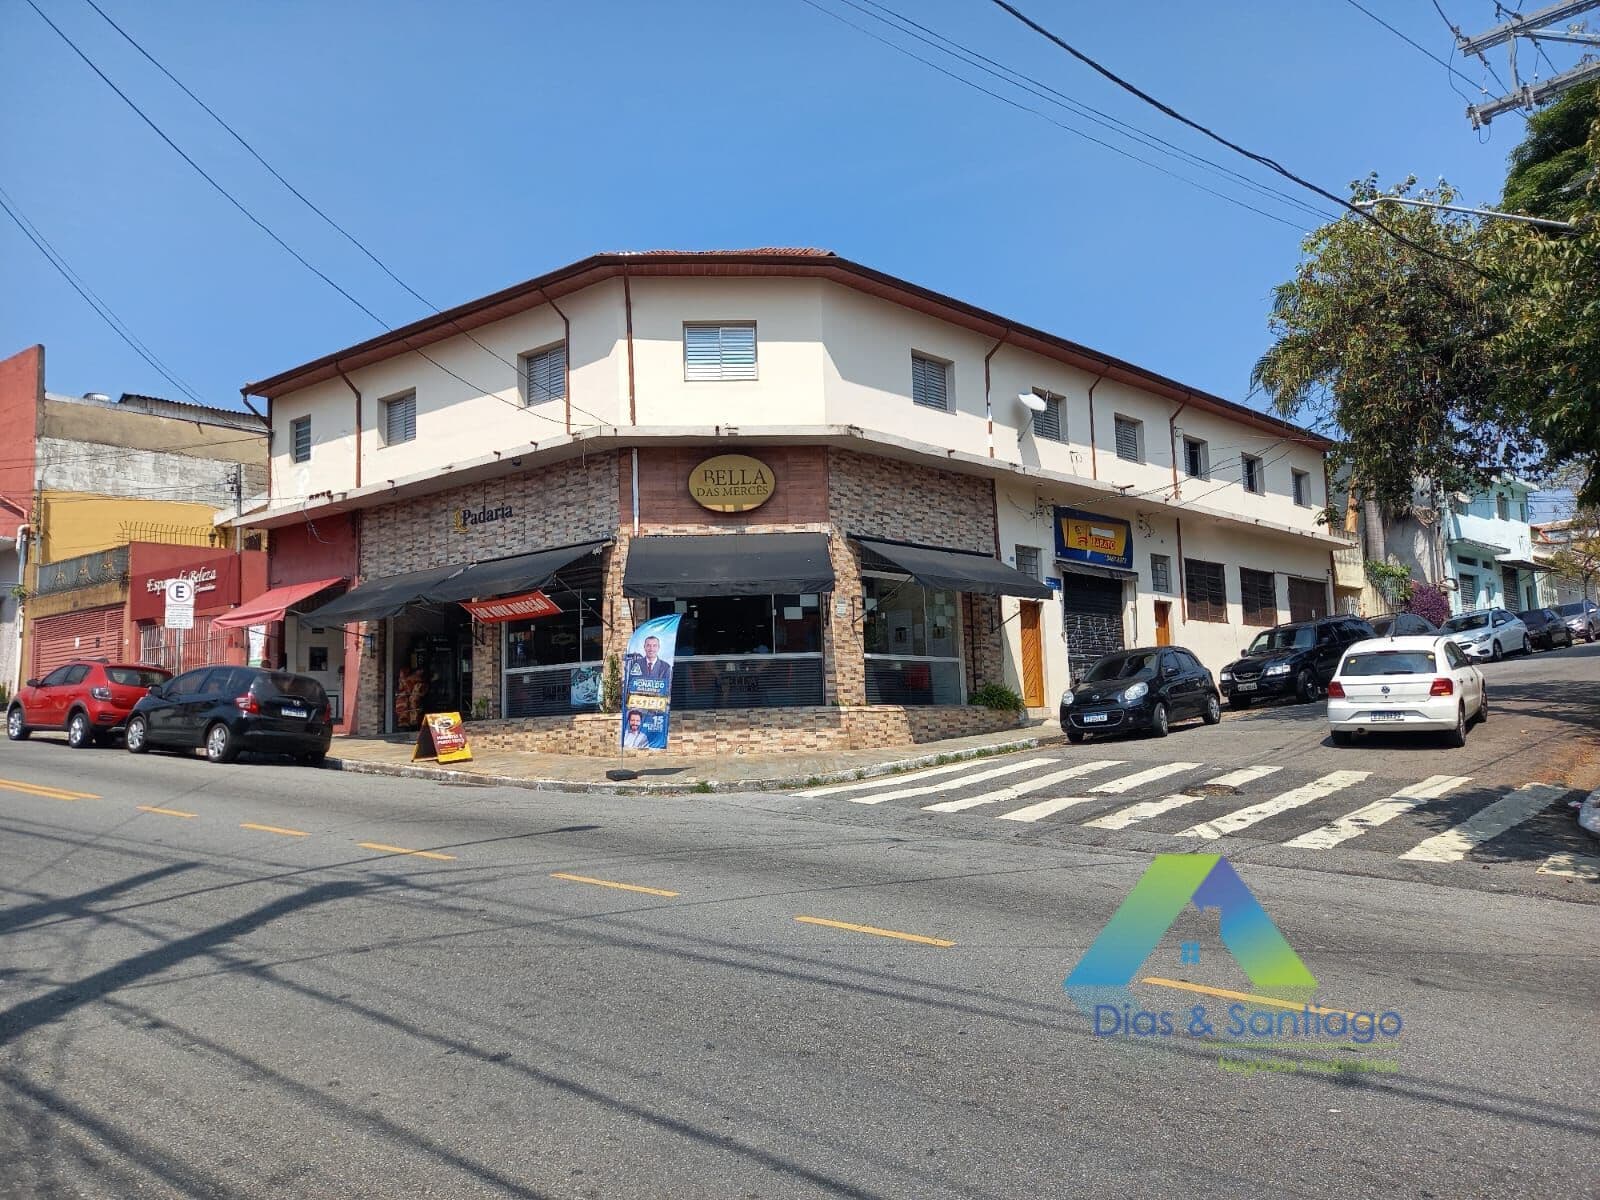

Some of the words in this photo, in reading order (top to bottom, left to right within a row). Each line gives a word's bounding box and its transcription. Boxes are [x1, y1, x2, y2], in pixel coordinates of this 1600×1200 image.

[704, 467, 767, 485] BELLA
[696, 487, 720, 497] DAS
[722, 485, 769, 496] MERCÊS
[461, 502, 513, 527] Padaria
[175, 585, 185, 599] E
[507, 597, 550, 614] DIREÇÃO
[633, 679, 665, 689] RONALDO
[652, 715, 664, 727] 15
